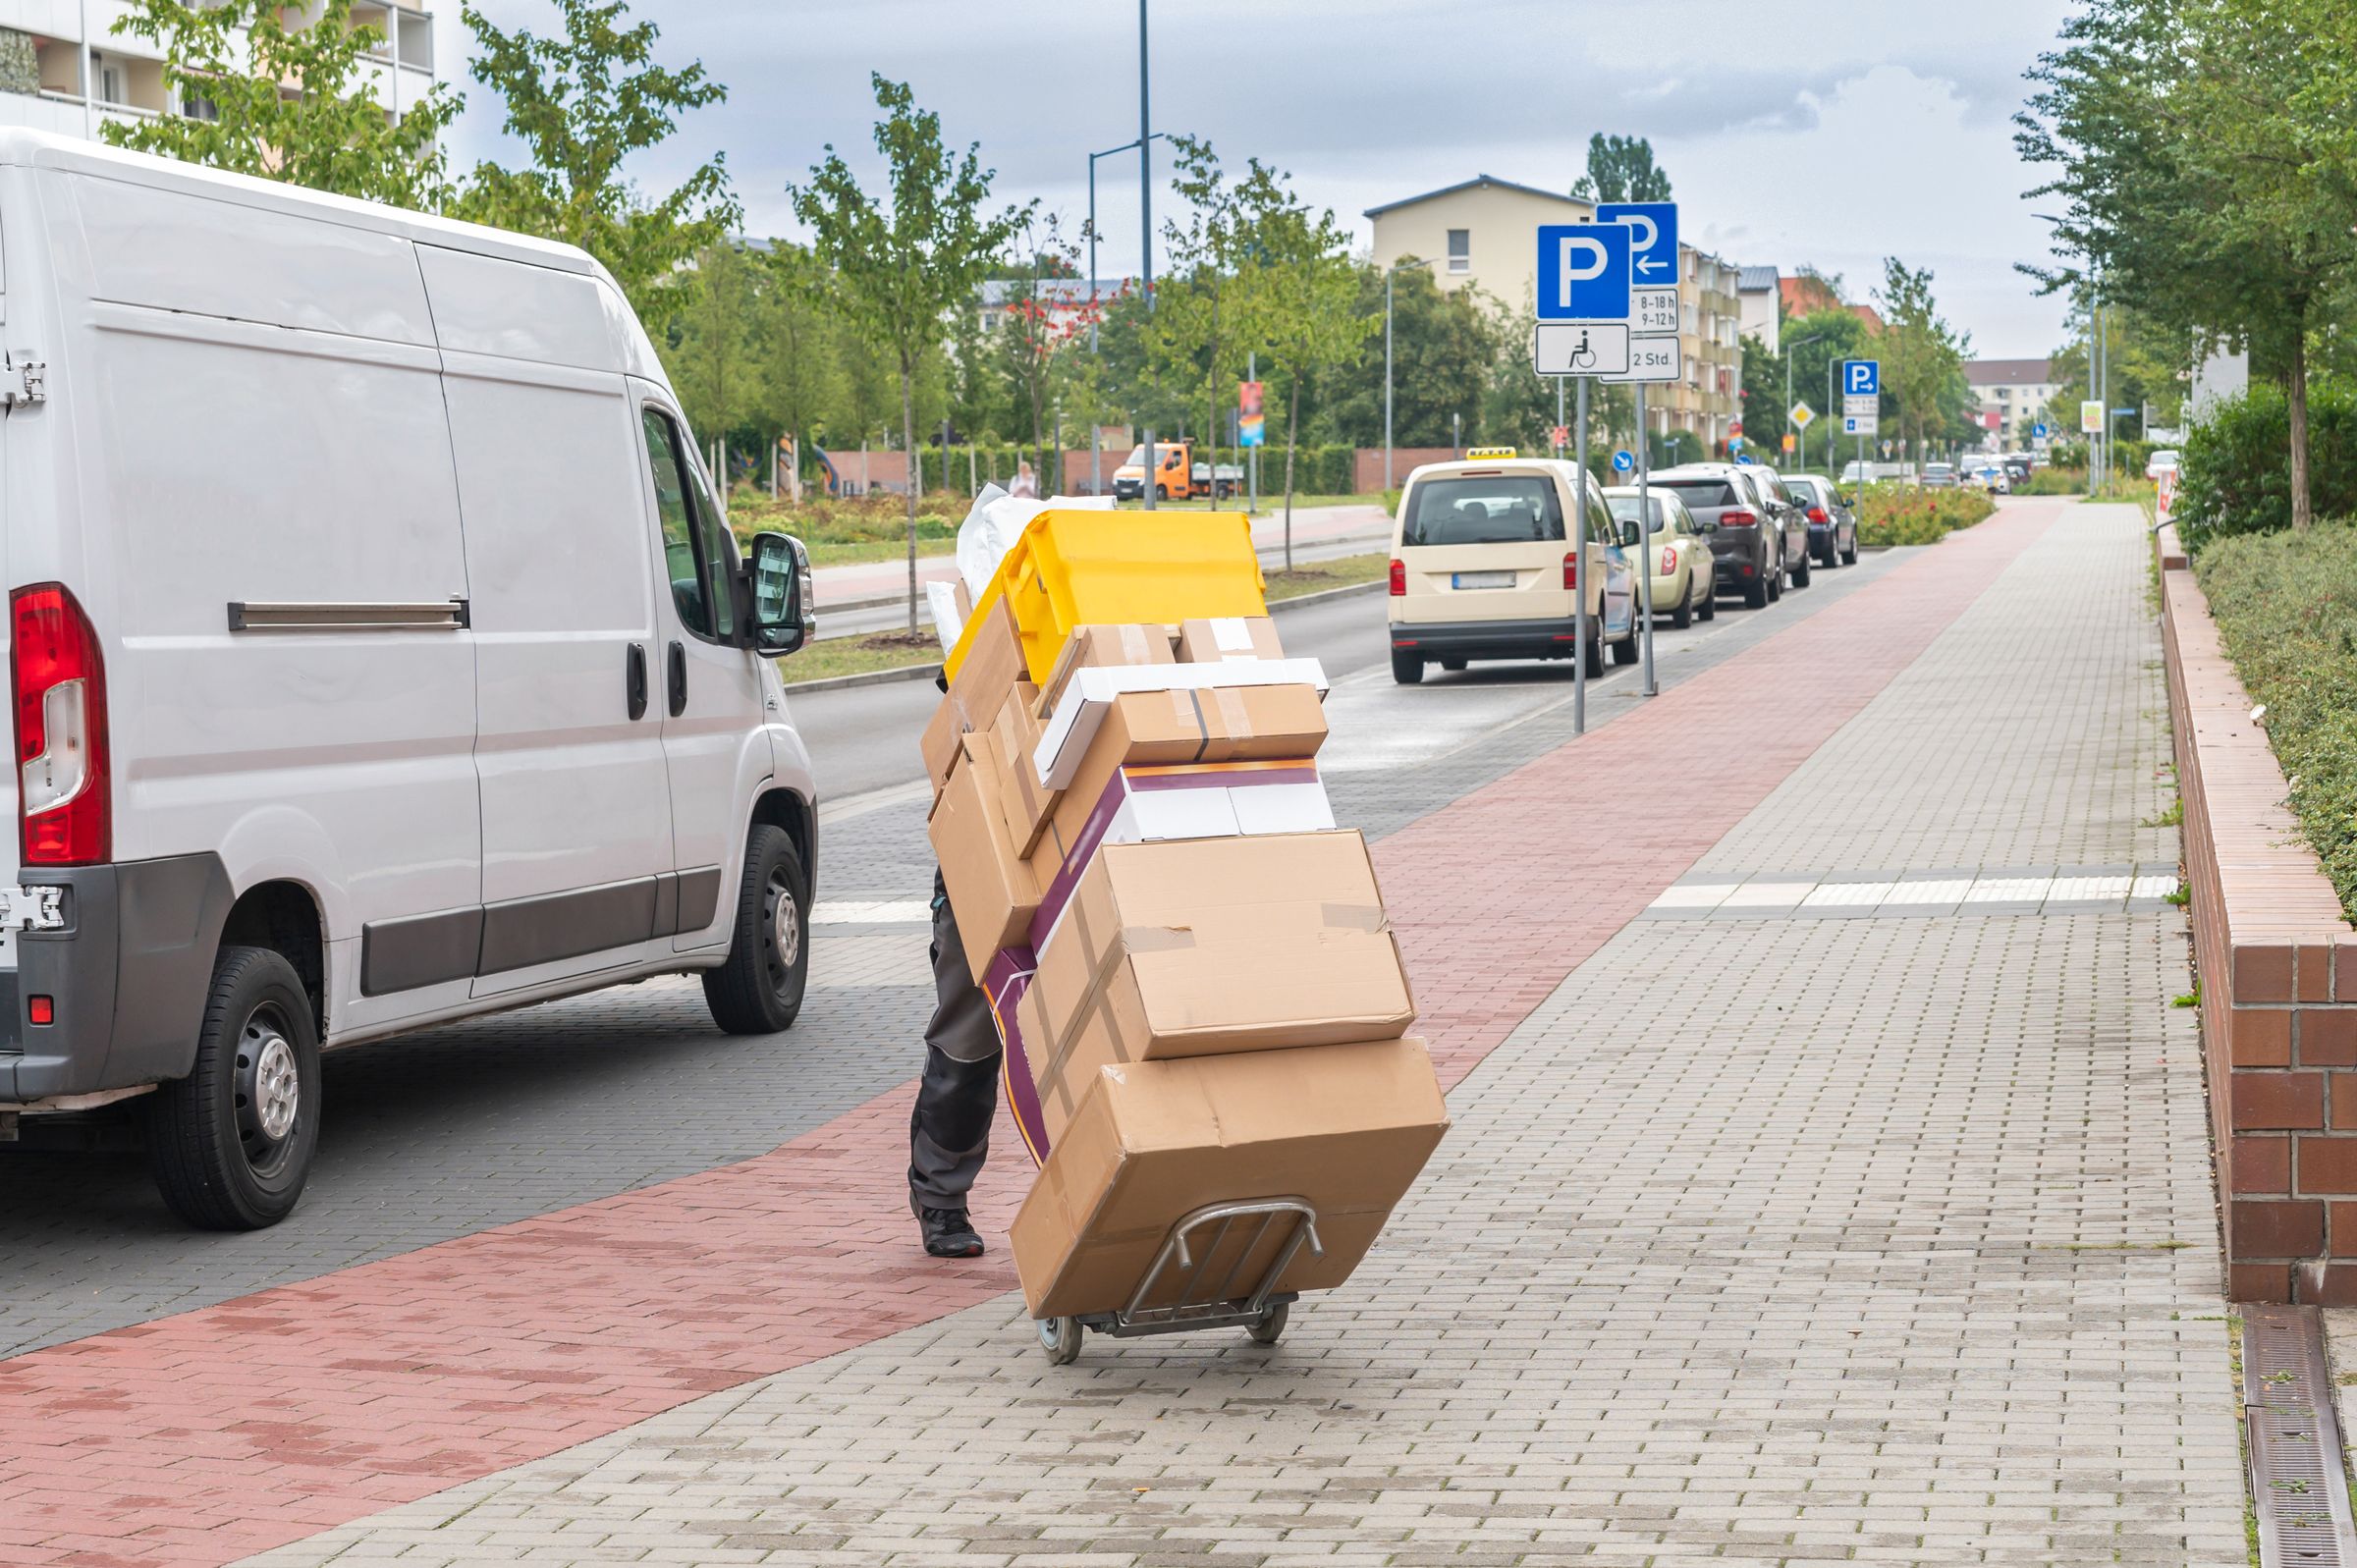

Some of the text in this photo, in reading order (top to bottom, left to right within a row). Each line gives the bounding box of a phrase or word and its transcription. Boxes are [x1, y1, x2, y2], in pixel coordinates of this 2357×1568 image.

[1560, 237, 1609, 307] P
[1641, 296, 1674, 309] 8-18 h
[1642, 312, 1675, 326] 9-12 h
[1633, 352, 1672, 366] 2 Std.
[1851, 364, 1871, 392] P
